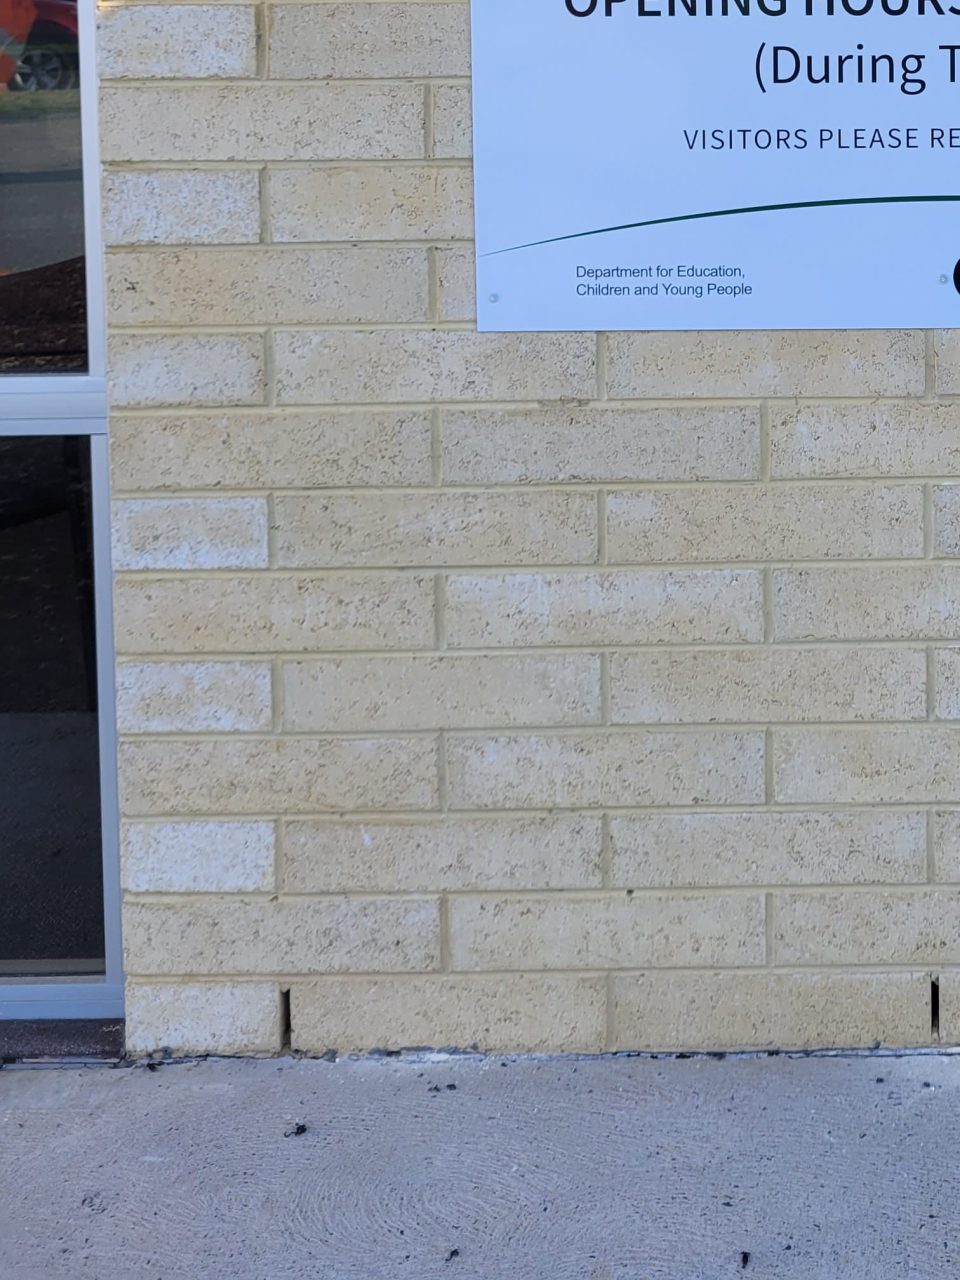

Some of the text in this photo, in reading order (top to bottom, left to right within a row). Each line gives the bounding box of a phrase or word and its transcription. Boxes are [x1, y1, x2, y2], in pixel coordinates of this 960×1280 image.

[755, 41, 926, 95] (During
[683, 128, 808, 150] VISITORS
[819, 128, 919, 150] PLEASE
[576, 264, 745, 281] Department for Education,
[576, 282, 753, 298] Children and Young People
